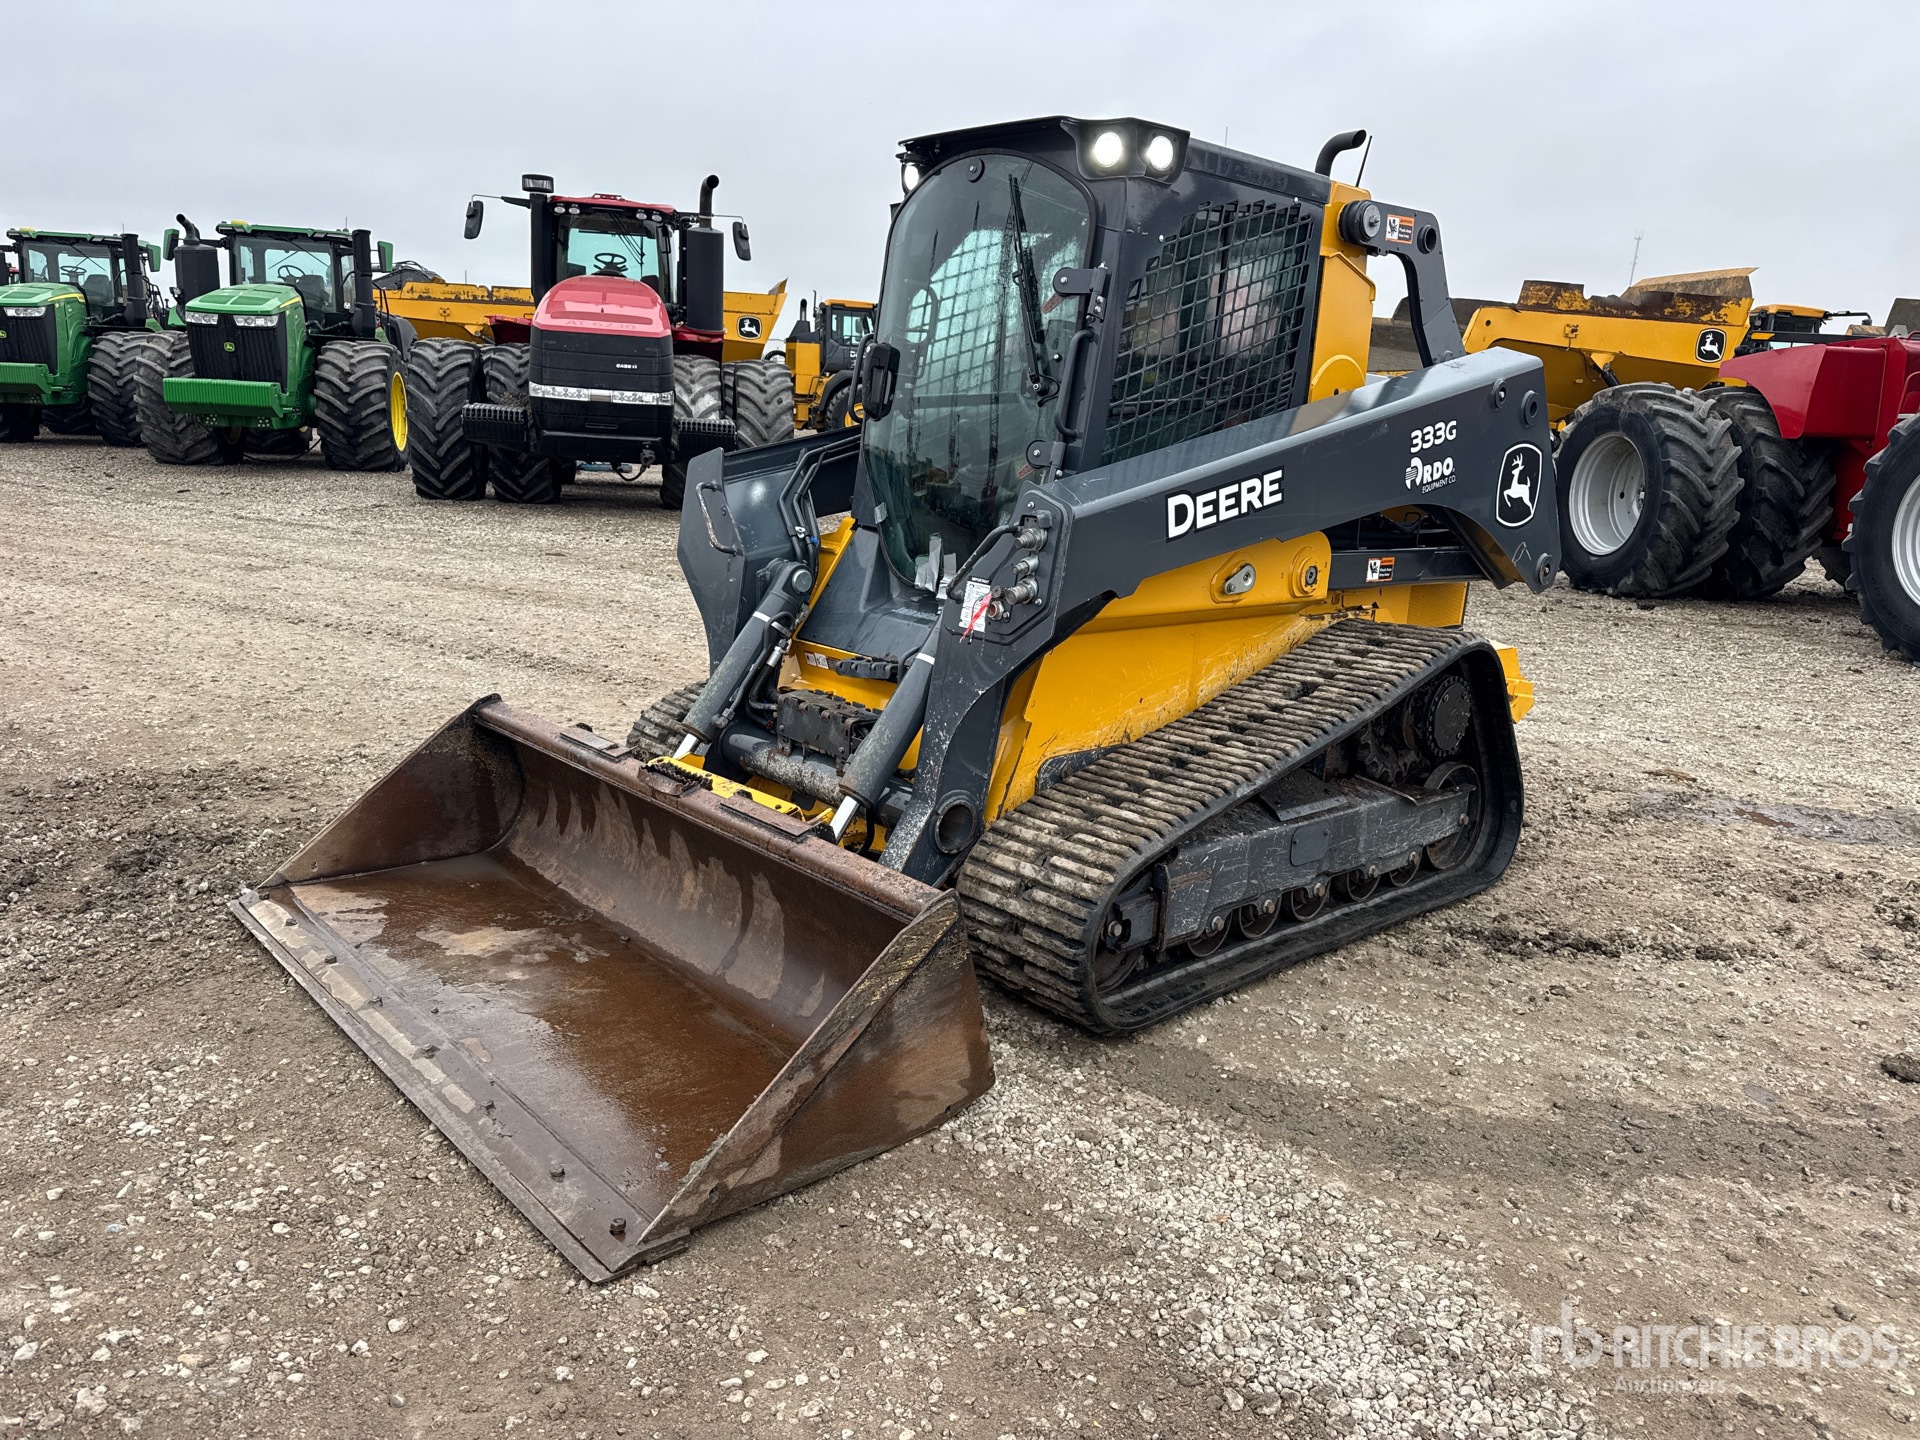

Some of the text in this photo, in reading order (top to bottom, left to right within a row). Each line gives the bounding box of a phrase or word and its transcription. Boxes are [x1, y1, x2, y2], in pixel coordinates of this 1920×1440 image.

[1410, 420, 1457, 453] 333G
[1421, 477, 1448, 493] EQUIPMENT
[1422, 456, 1454, 484] RDO
[1167, 469, 1283, 539] DEERE
